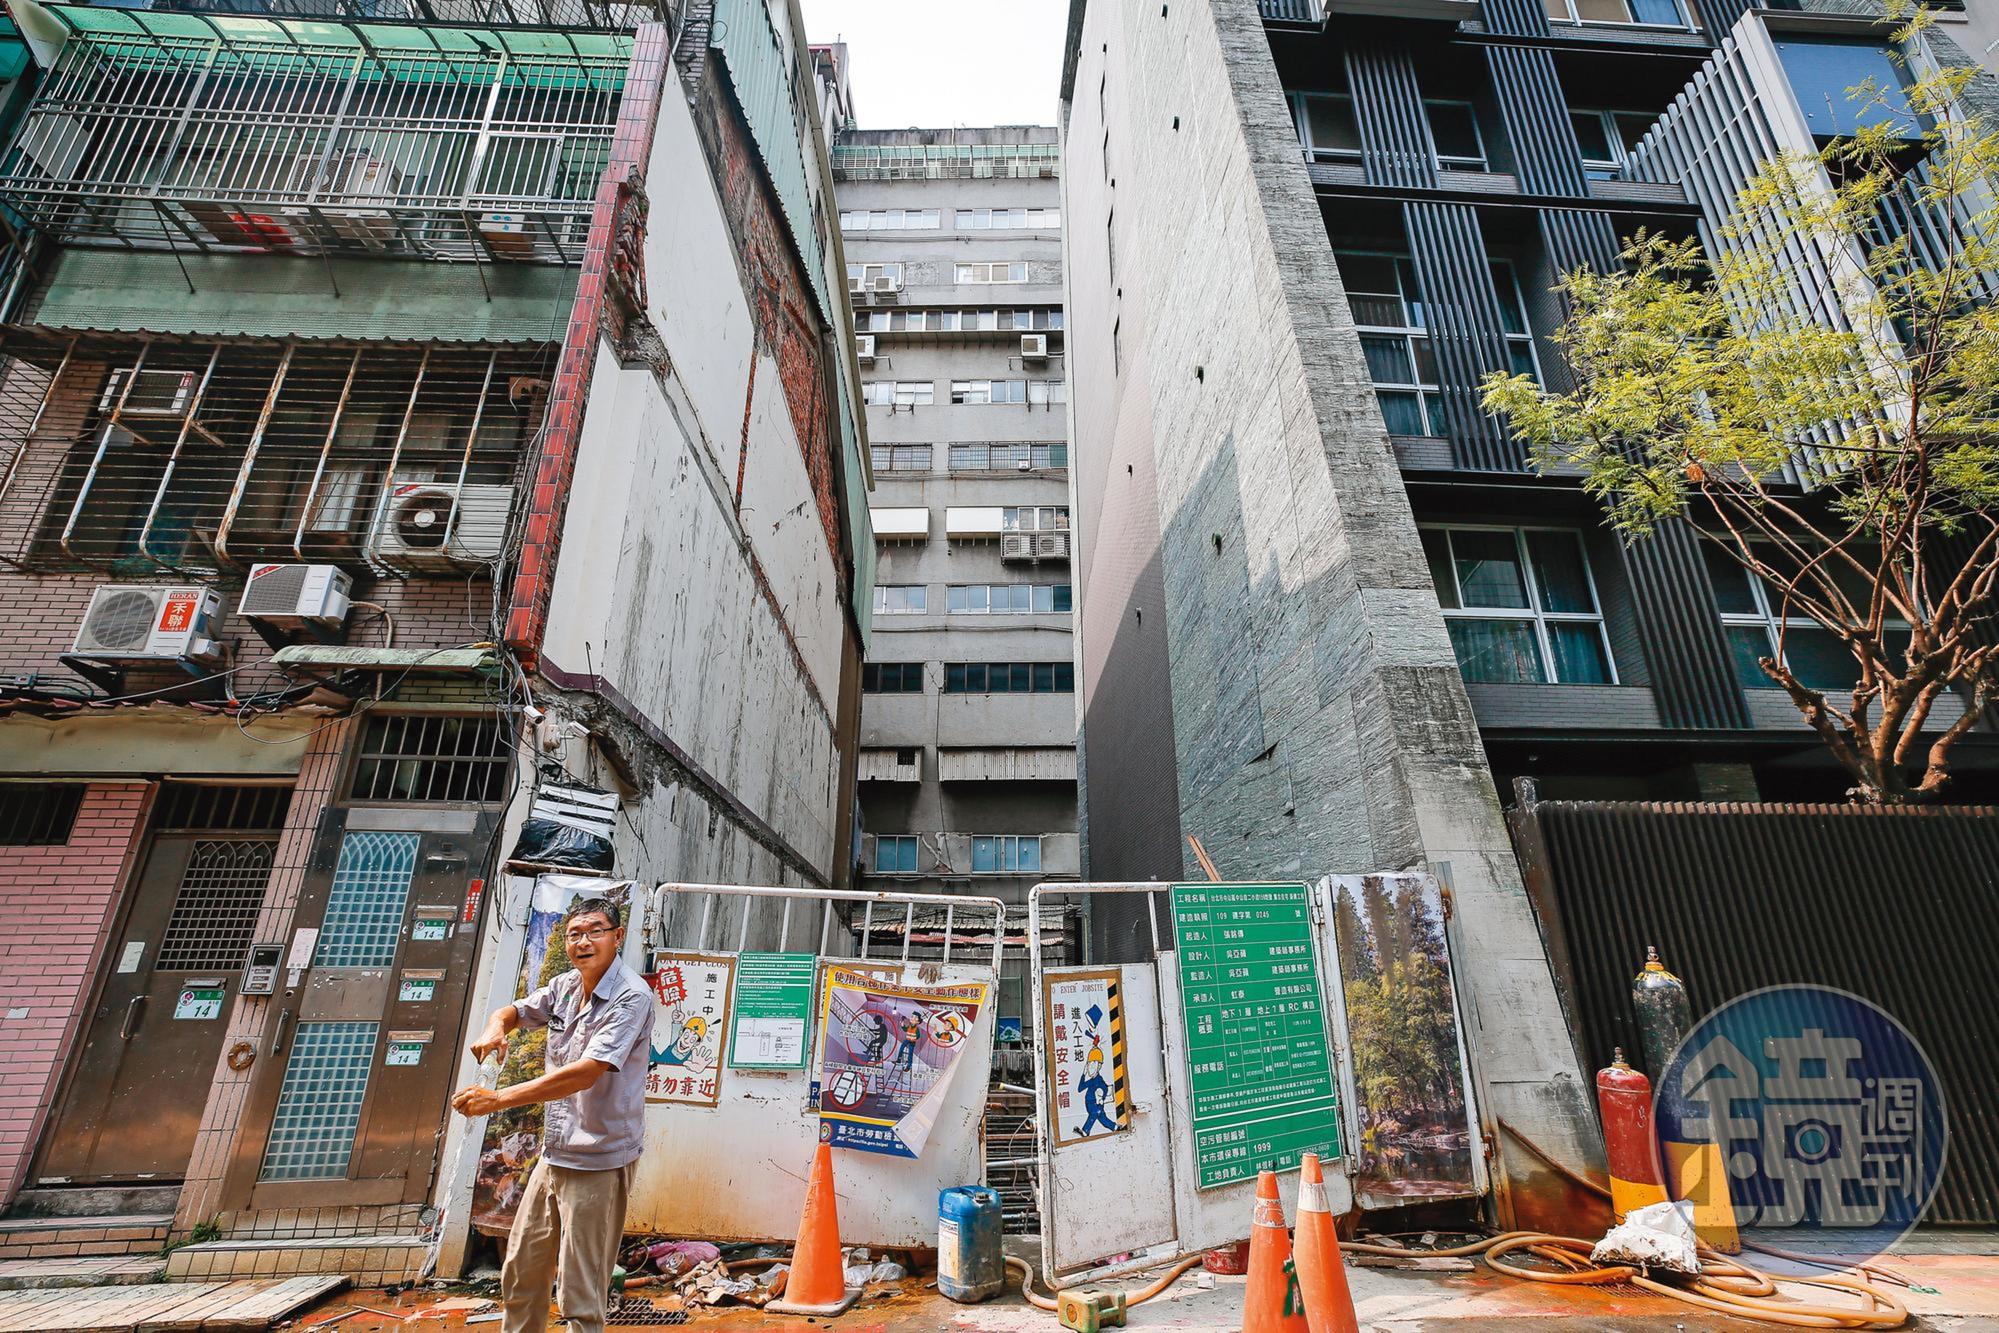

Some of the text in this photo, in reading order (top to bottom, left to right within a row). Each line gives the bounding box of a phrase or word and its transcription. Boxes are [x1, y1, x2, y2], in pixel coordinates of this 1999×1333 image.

[168, 602, 187, 627] 禾聯
[1177, 894, 1207, 903] 工程名稱
[1179, 913, 1208, 922] 建造執照
[1186, 932, 1208, 941] 起造人
[1188, 951, 1210, 961] 設計人
[1269, 944, 1307, 956] 建築師事務所
[1190, 970, 1213, 981] 監造人
[1271, 963, 1310, 975] 建築師事務所
[660, 971, 681, 1002] 危險
[702, 972, 718, 1016] 施工中
[1081, 983, 1104, 993] JOBSITE
[1193, 993, 1215, 1003] 承造人
[1274, 984, 1313, 996] 營造有限公司
[1288, 1002, 1300, 1011] RC
[1198, 1015, 1212, 1025] 工程
[1071, 1007, 1085, 1062] 進入工地
[1053, 1003, 1070, 1109] 請戴安全帽
[1194, 1061, 1225, 1074] 服務電話
[645, 1073, 716, 1098] 請勿靠近
[1200, 1129, 1246, 1147] 空污管制編號
[1201, 1142, 1272, 1164] 本市環保專線 1999
[1206, 1165, 1245, 1182] 工地負責人
